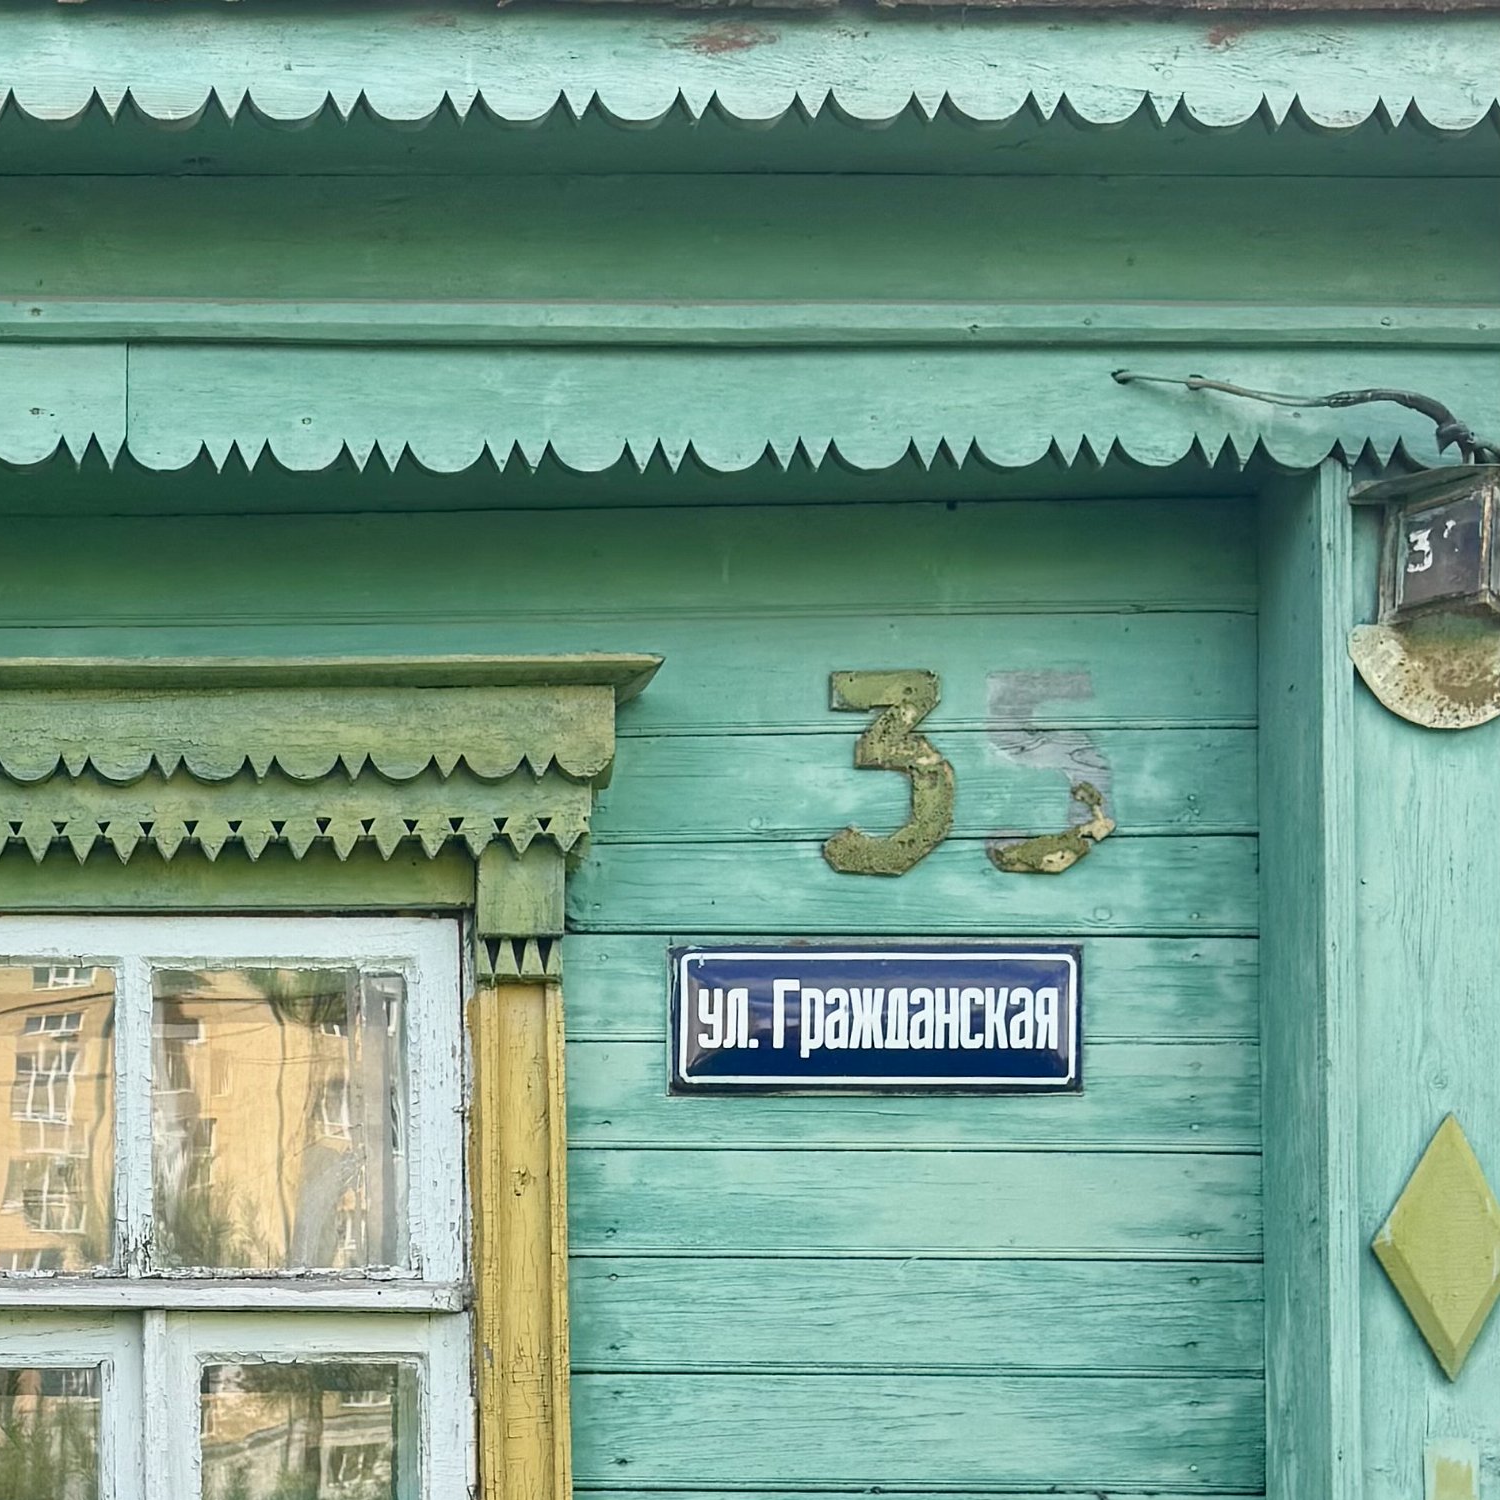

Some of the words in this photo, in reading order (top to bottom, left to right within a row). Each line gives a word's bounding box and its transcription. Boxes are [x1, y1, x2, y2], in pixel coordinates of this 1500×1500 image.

[822, 669, 1116, 877] 35
[698, 987, 760, 1050] ул.
[772, 978, 1060, 1059] Гражданская
